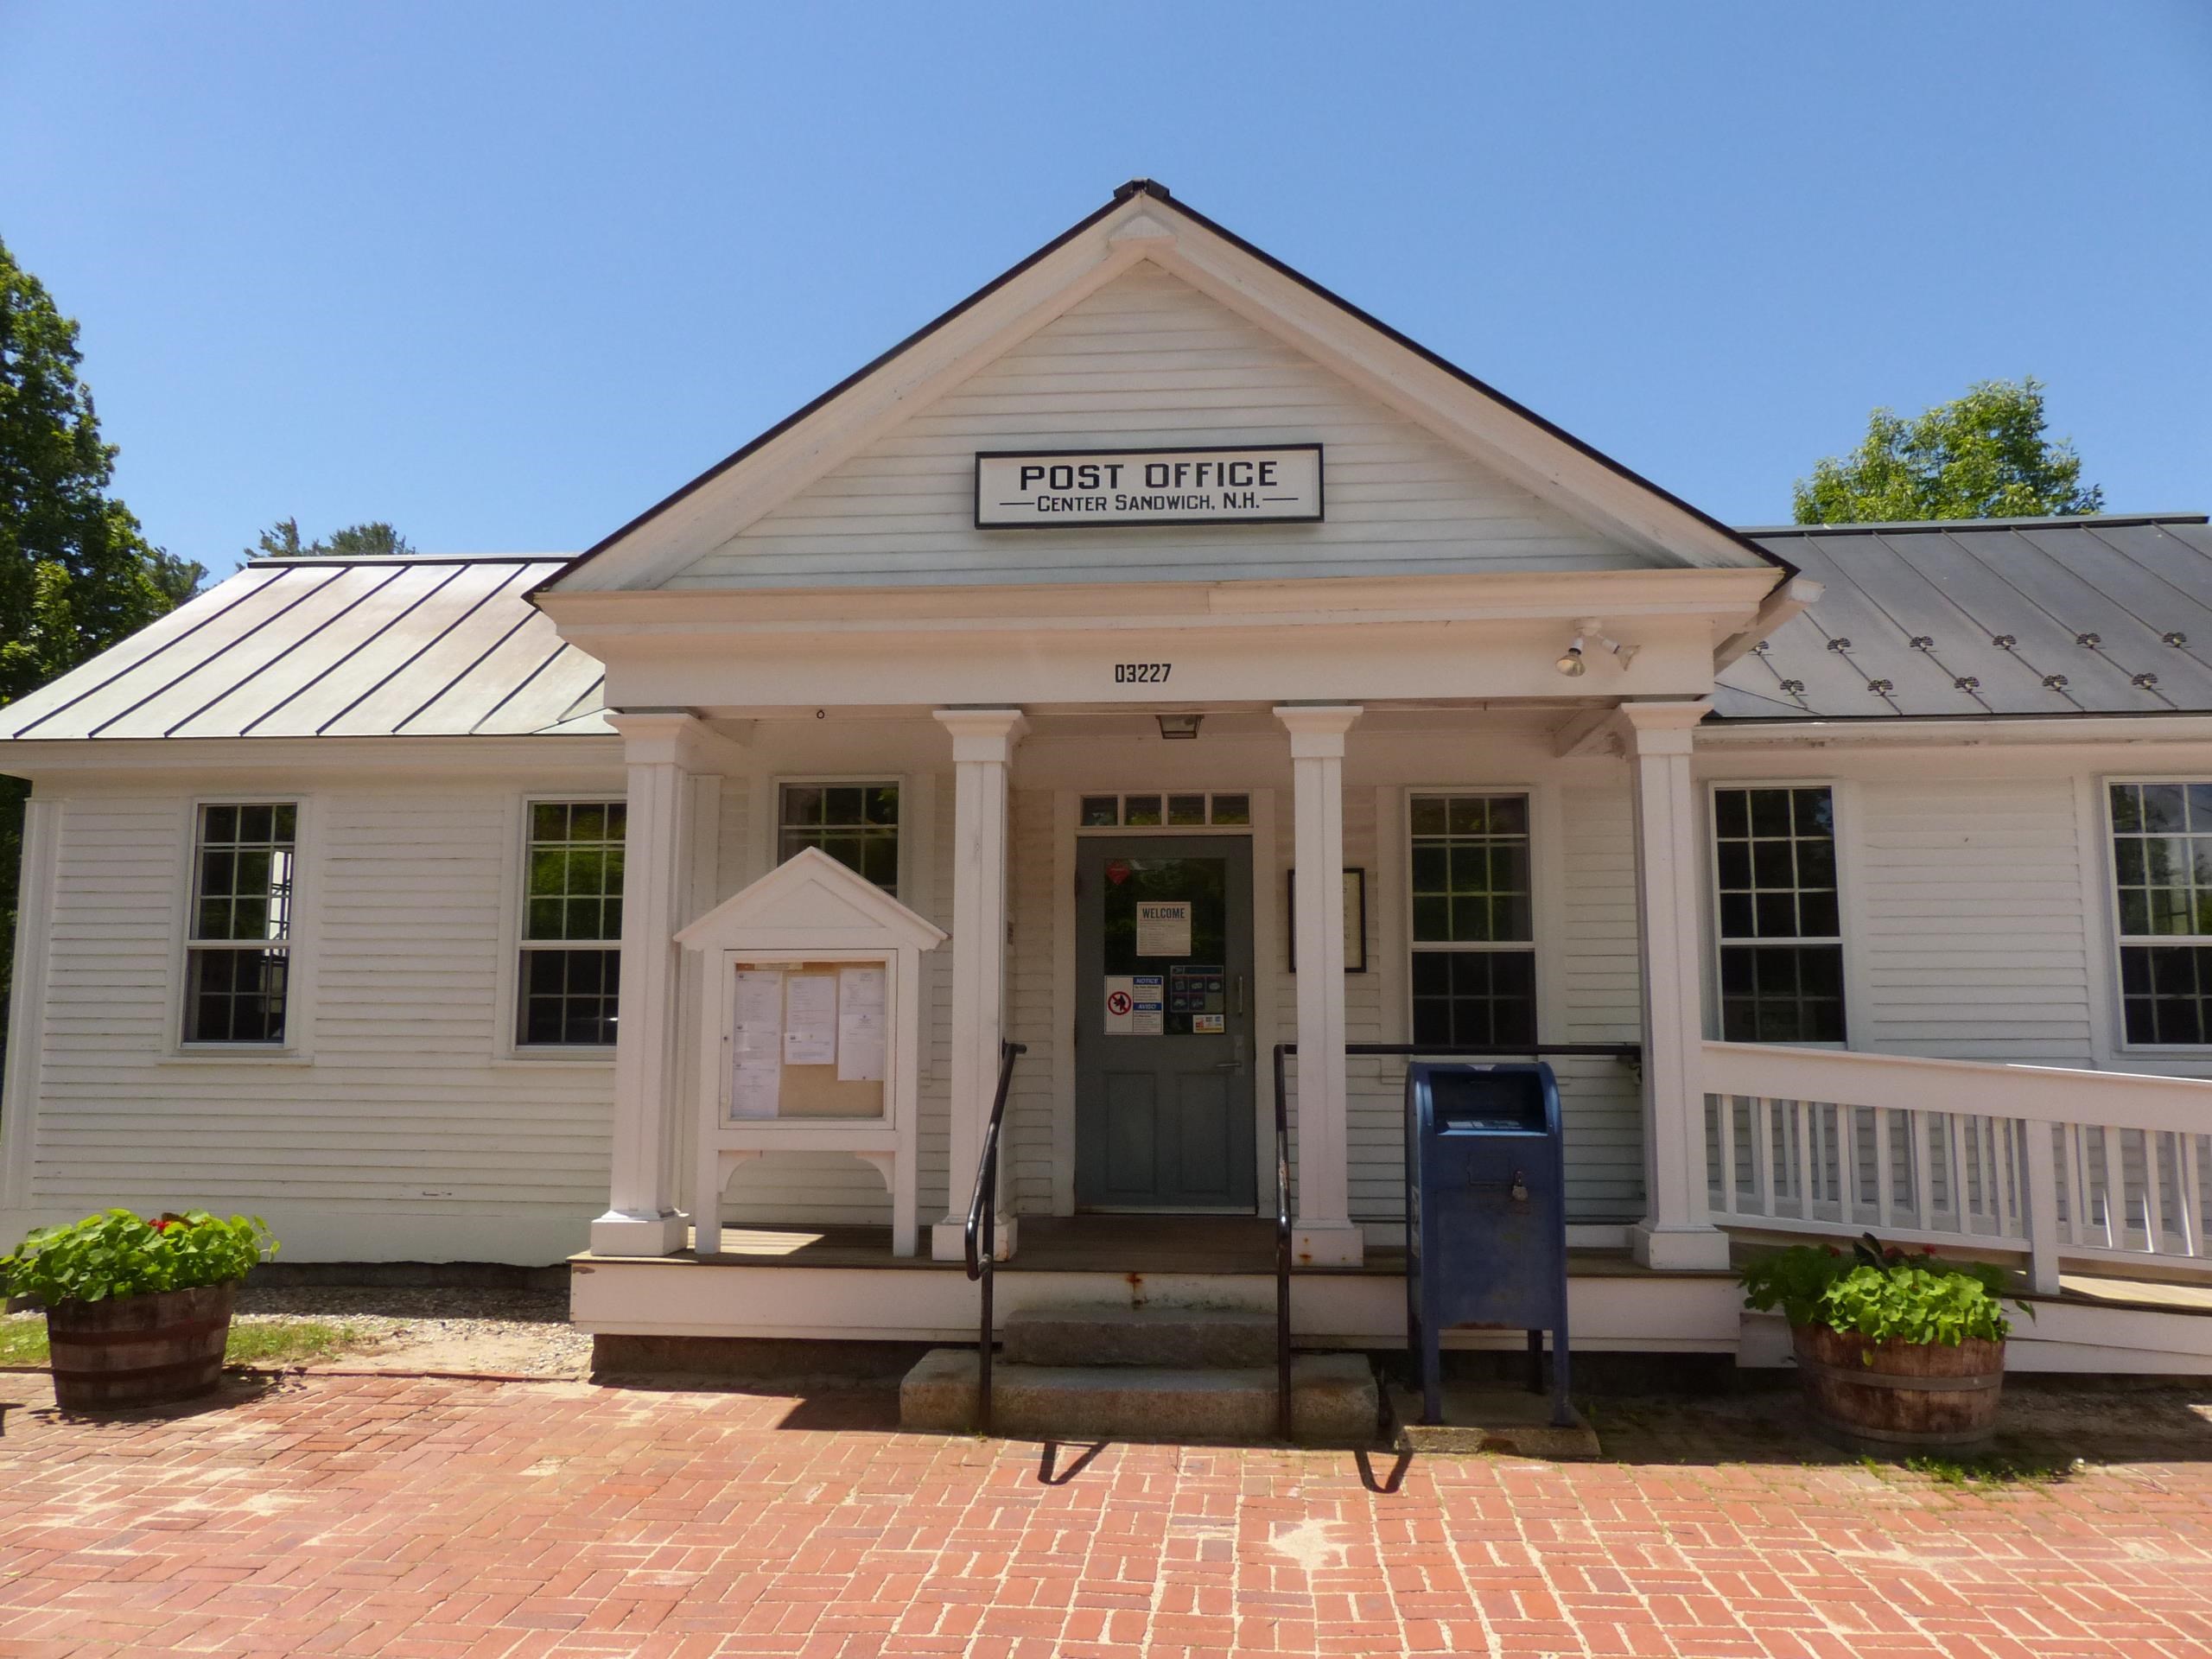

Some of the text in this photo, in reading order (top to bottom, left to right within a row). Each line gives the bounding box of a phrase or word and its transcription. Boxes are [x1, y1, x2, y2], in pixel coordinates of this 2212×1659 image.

[1020, 461, 1278, 491] POST OFFICE
[1037, 492, 1261, 512] CENTER SANDWICH, N.H.
[1115, 664, 1172, 683] 03227
[1141, 907, 1185, 919] WELCOME
